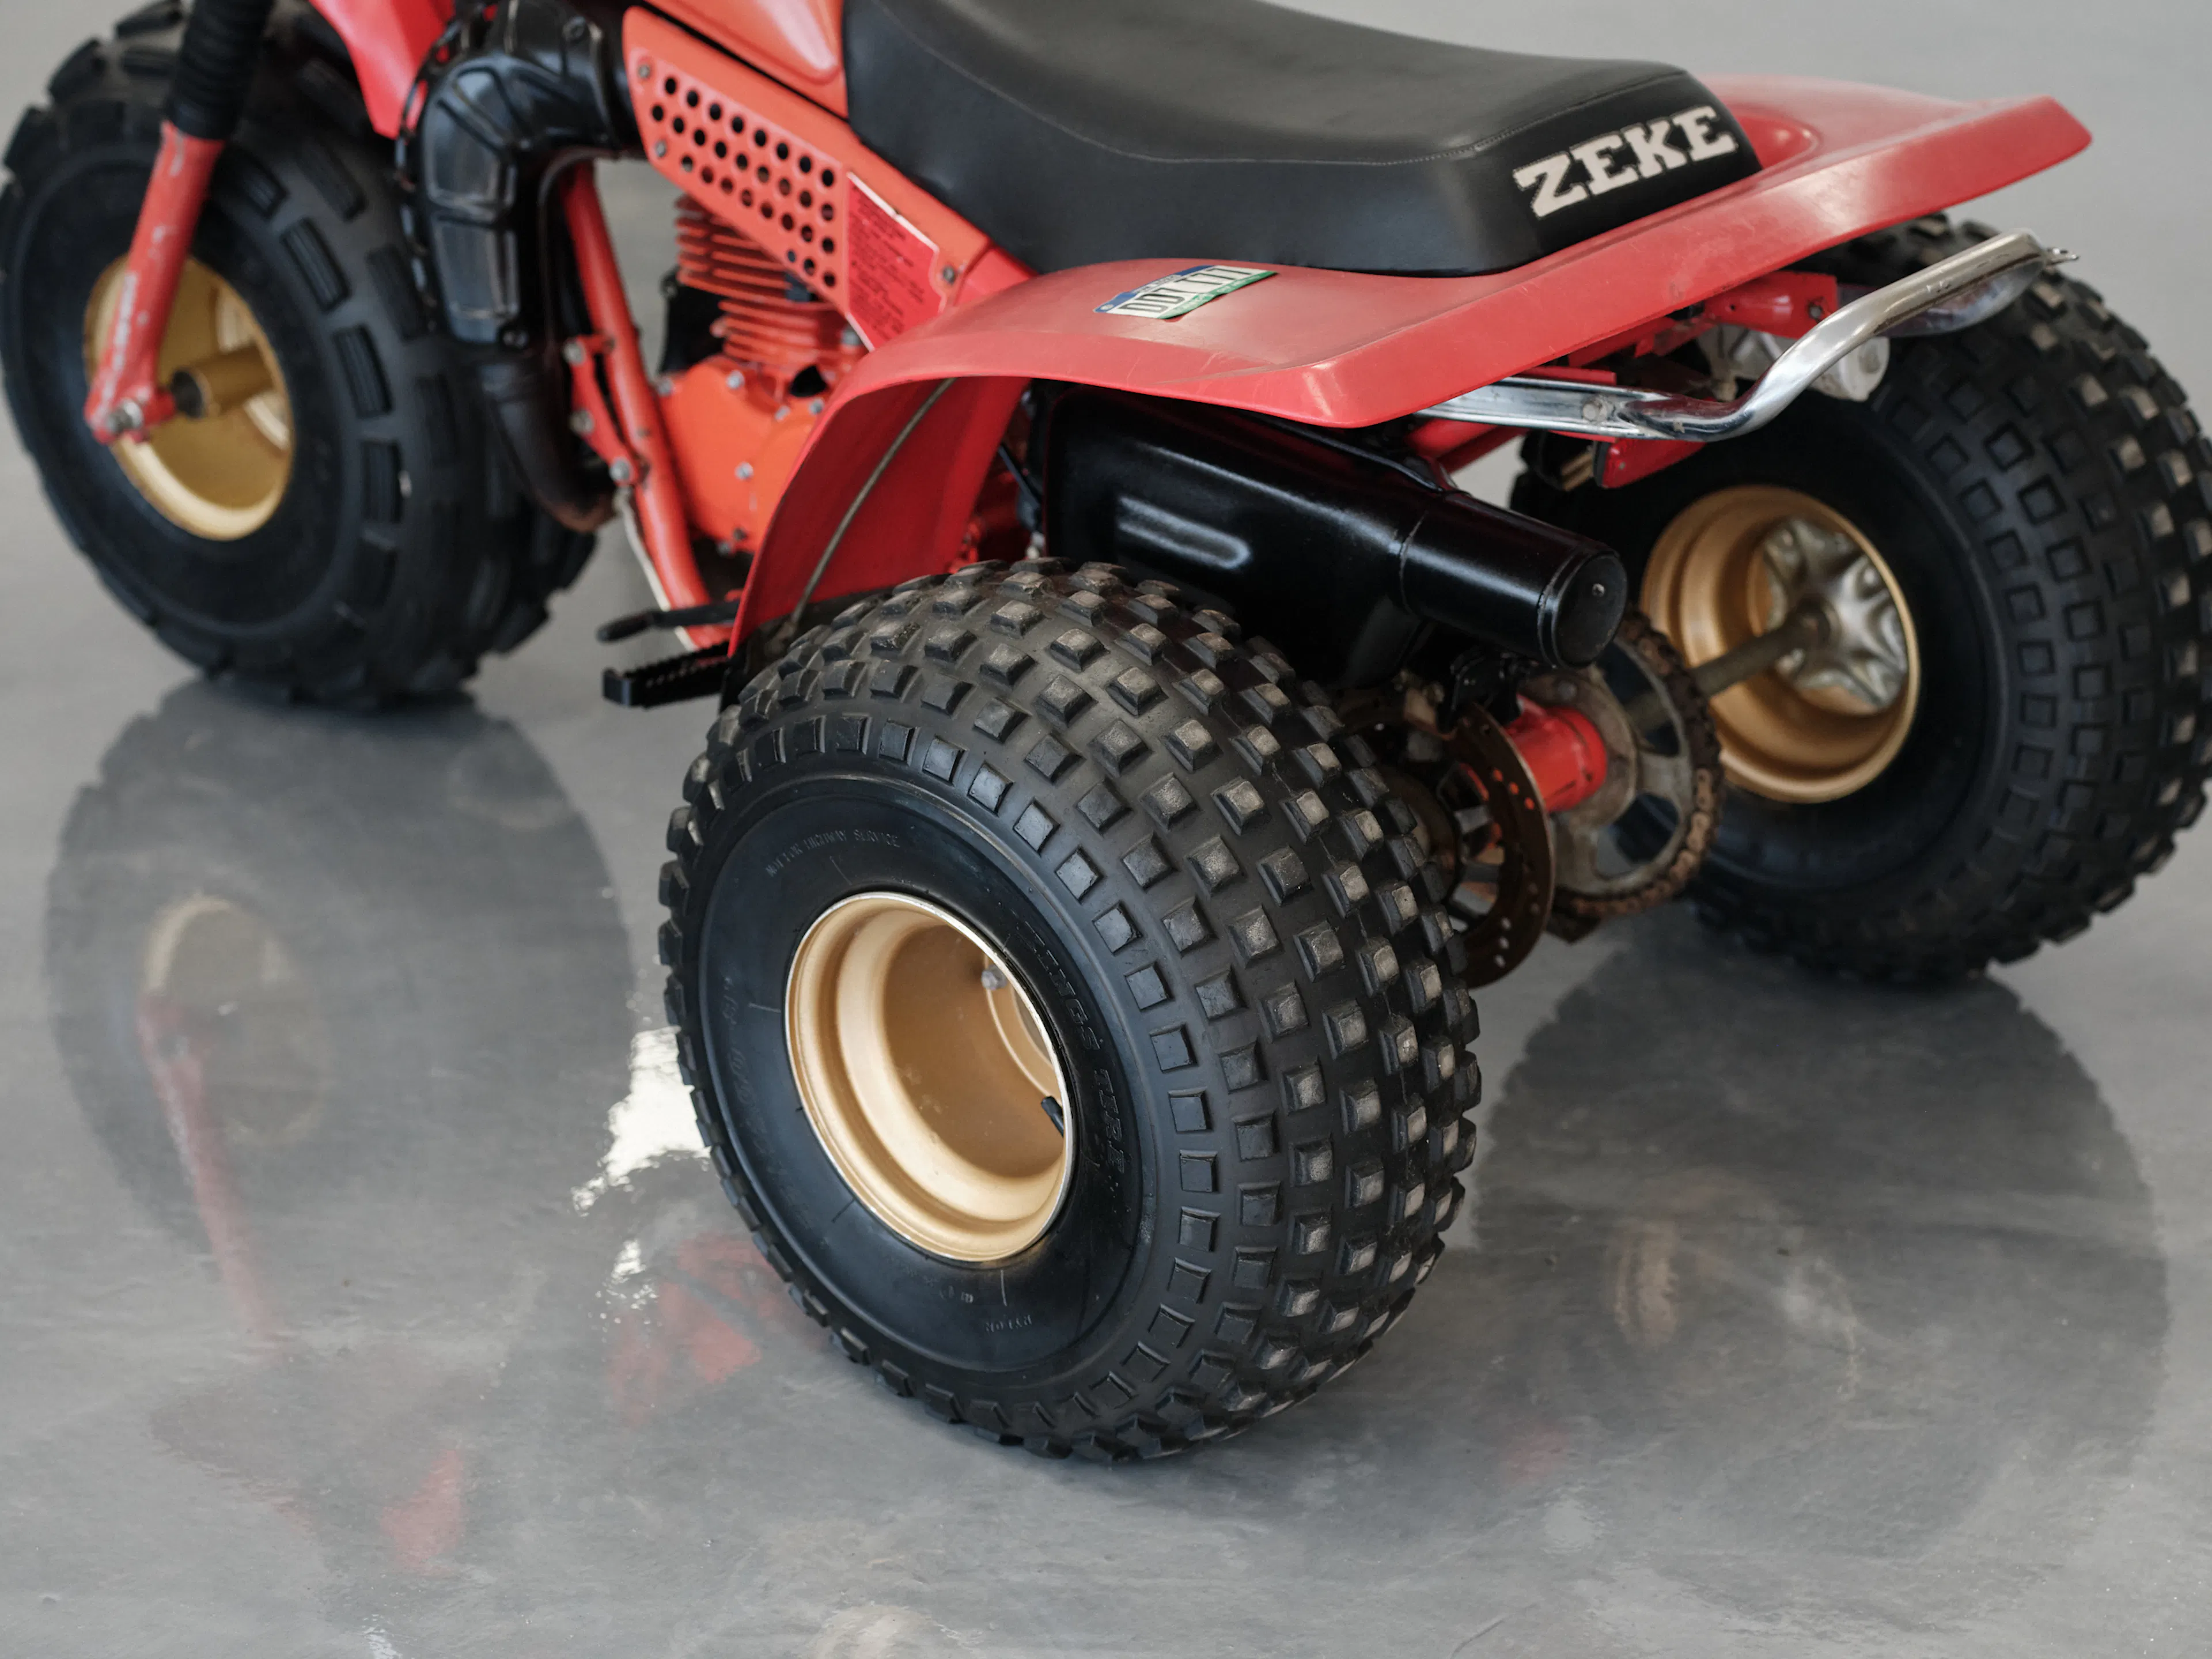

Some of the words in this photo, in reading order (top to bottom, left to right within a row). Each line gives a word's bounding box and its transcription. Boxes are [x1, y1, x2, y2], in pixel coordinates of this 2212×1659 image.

[1512, 105, 1739, 220] ZEKE
[802, 830, 847, 851] HIGHWAY
[853, 829, 900, 848] SERVICE
